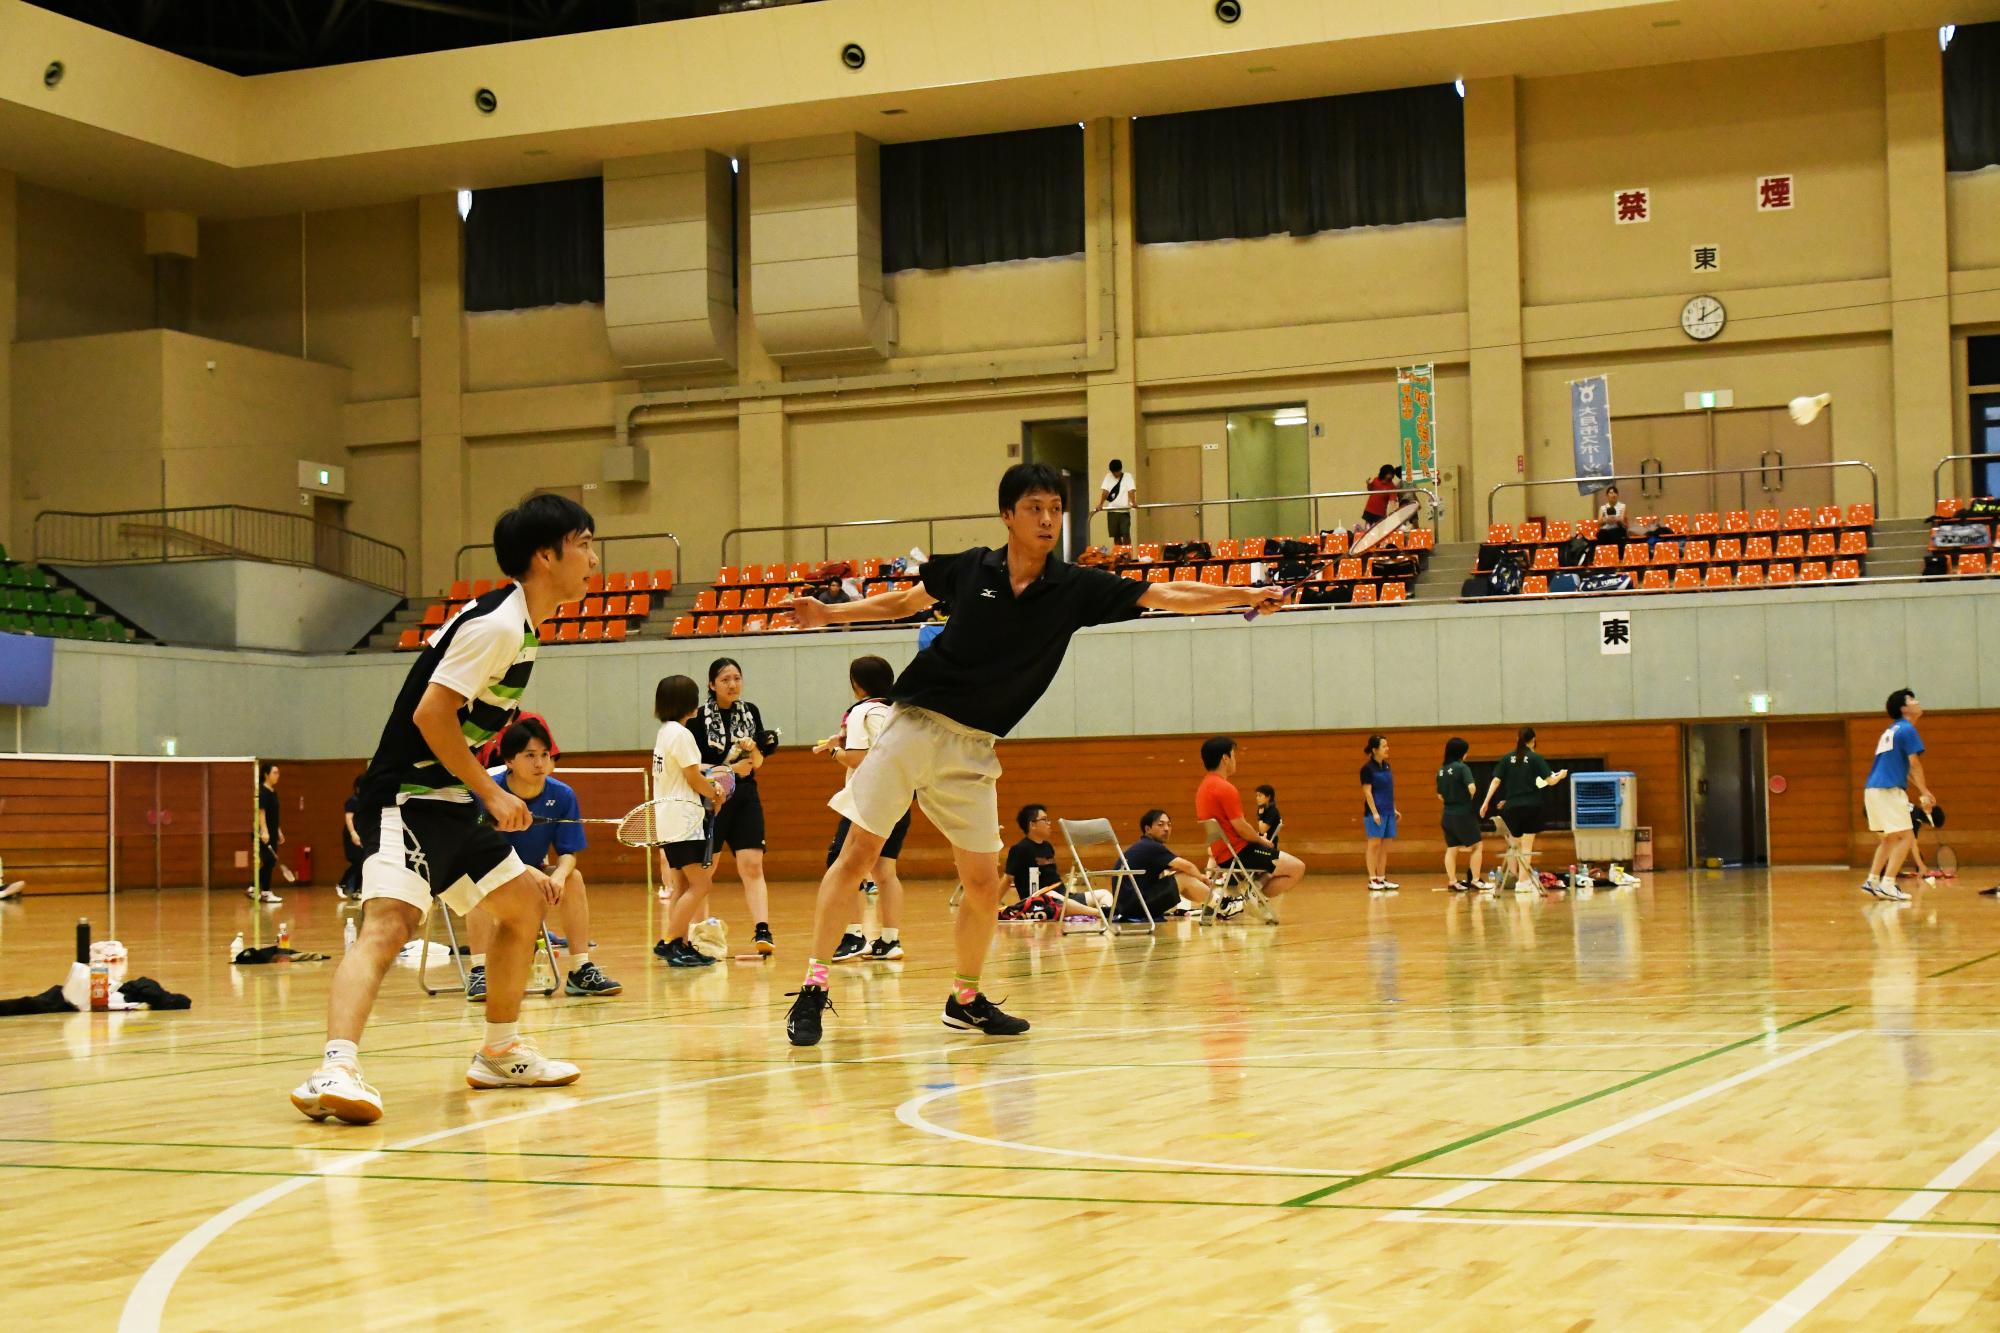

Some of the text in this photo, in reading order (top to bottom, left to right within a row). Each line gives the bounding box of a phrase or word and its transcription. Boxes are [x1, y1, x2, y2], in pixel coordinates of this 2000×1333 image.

[1617, 177, 1791, 221] 禁 煙
[1694, 247, 1717, 270] 東
[1603, 618, 1629, 645] 東
